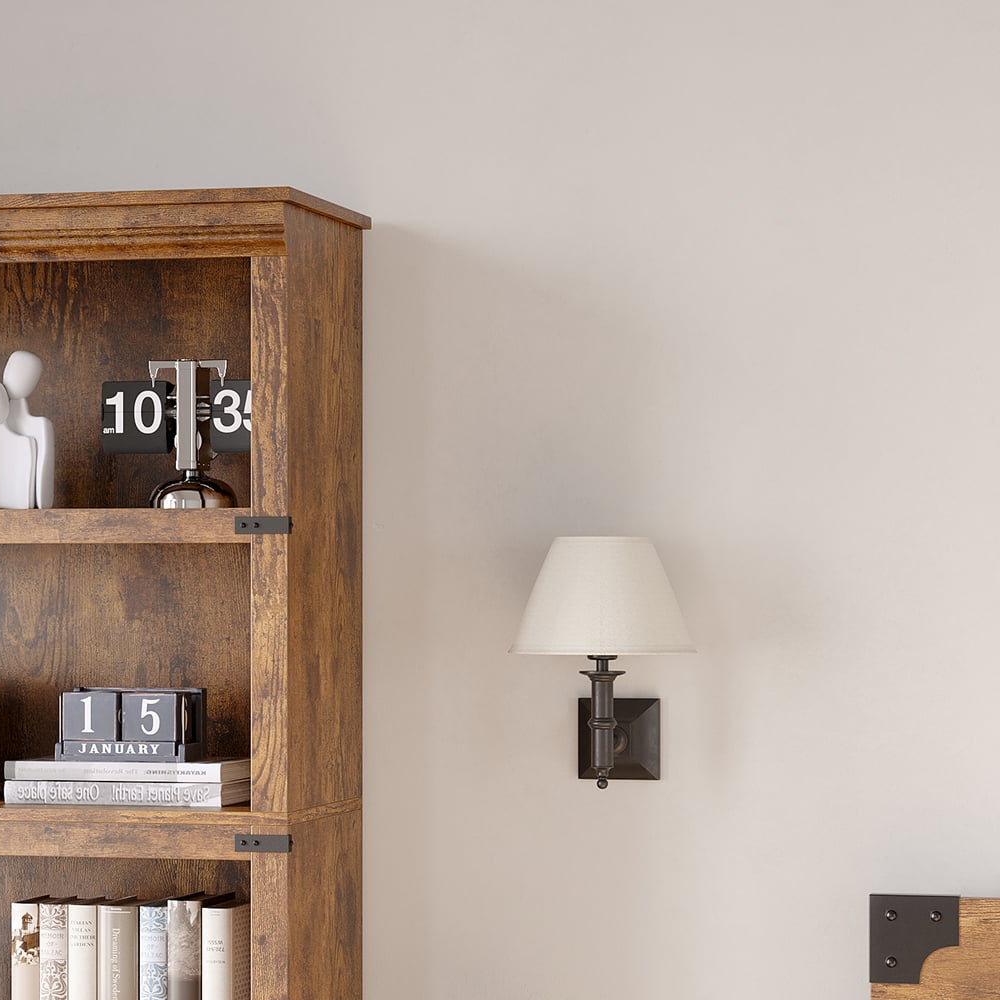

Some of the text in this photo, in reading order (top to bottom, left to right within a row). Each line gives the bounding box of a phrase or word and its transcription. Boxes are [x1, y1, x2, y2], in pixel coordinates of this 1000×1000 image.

[106, 390, 162, 434] 10
[80, 696, 160, 736] 1 5
[78, 743, 160, 754] JANUARY
[112, 928, 120, 964] Dreaming
[112, 965, 120, 973] of
